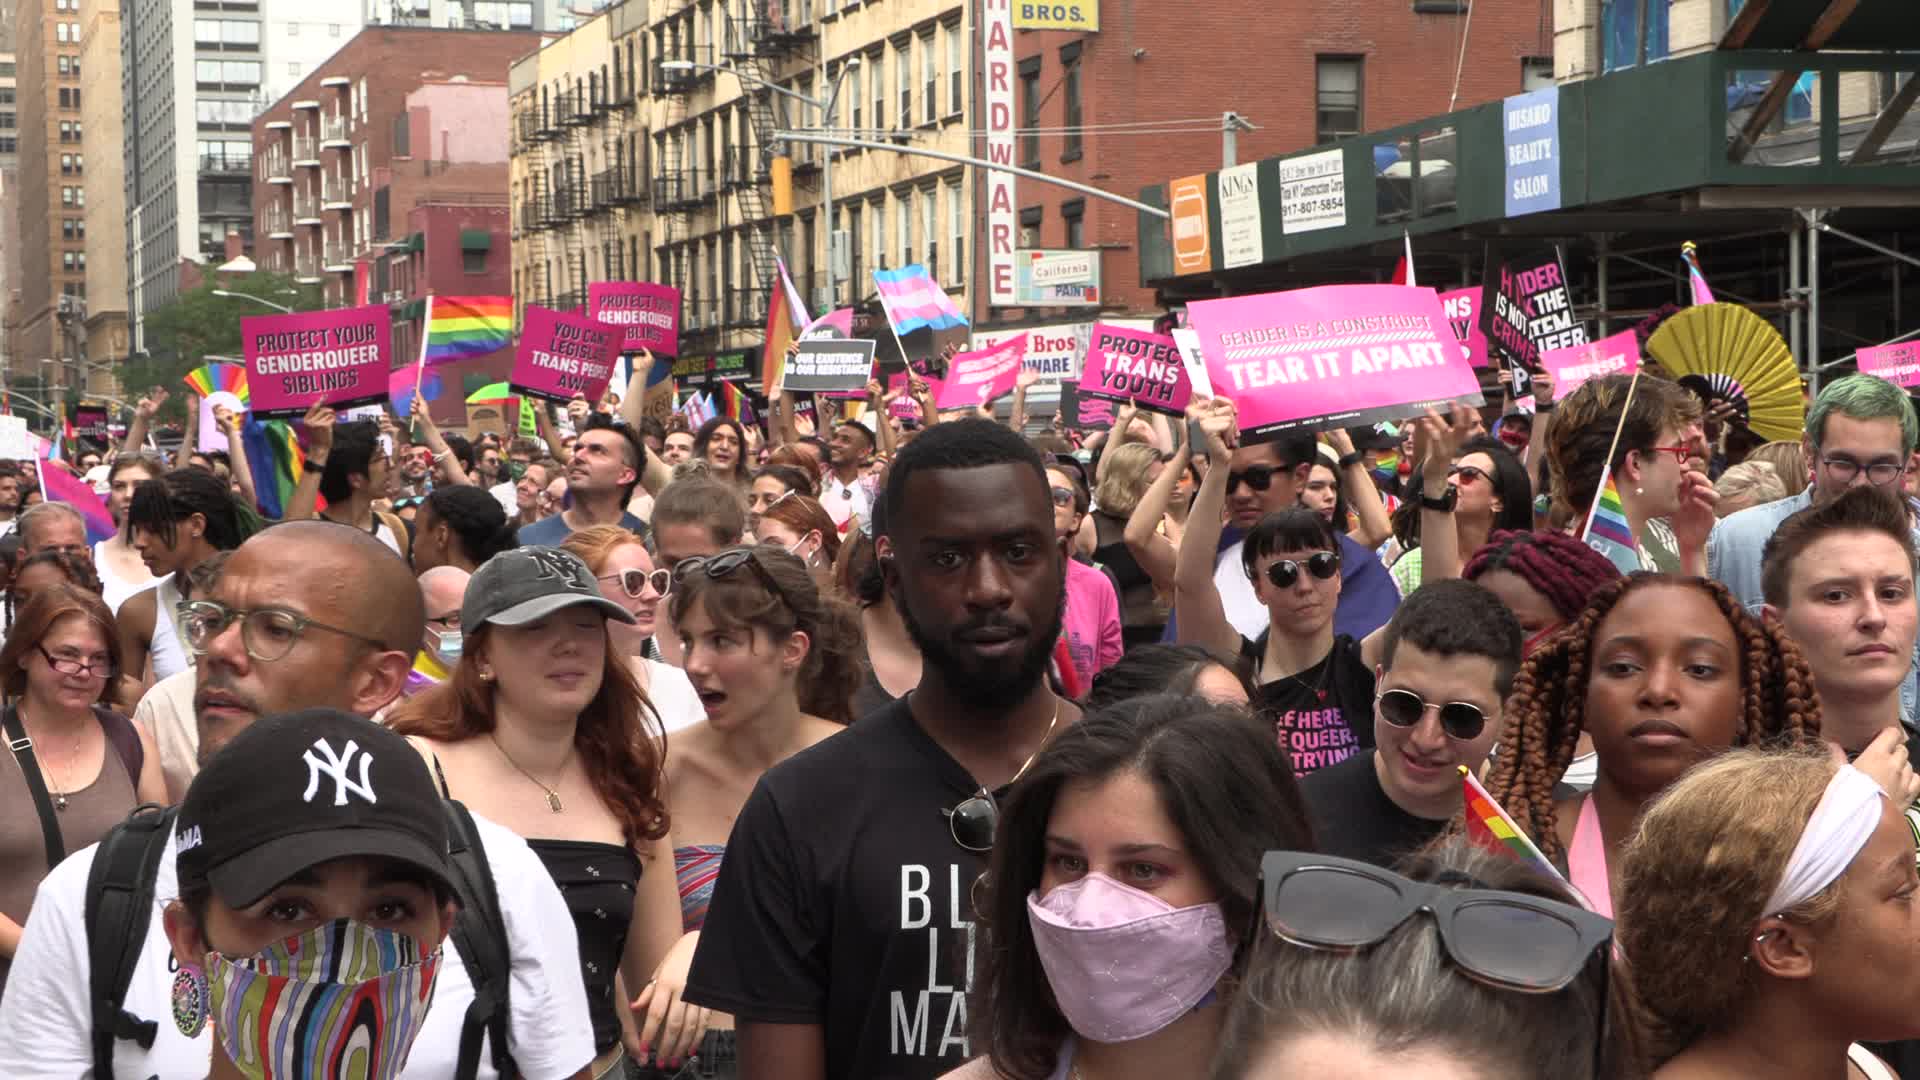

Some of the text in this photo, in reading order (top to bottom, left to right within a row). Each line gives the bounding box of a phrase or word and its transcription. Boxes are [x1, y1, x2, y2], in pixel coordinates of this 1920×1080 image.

[1021, 4, 1086, 22] BROS.
[1508, 103, 1551, 131] HISAKO
[1508, 138, 1552, 166] BEAUTY
[1222, 175, 1254, 198] KINGS
[1513, 175, 1549, 200] SALON
[1281, 197, 1343, 216] 917-807-5854
[1036, 264, 1088, 277] California
[599, 295, 654, 310] PROTECT
[1495, 292, 1507, 317] IS
[1507, 302, 1528, 336] NOT
[1534, 287, 1568, 315] THE
[554, 322, 582, 341] YOU
[598, 310, 673, 330] GENDERQUEER
[1219, 327, 1288, 347] GENDER
[1293, 324, 1310, 338] IS
[1316, 322, 1328, 336] A
[1331, 314, 1432, 335] CONSTRUCT
[256, 324, 376, 353] PROTECT YOUR
[1033, 335, 1076, 353] Bros
[1098, 333, 1184, 367] PROTEC
[1492, 315, 1536, 367] CRIME
[256, 345, 379, 375] GENDERQUEER
[531, 350, 579, 375] TRANS
[795, 353, 864, 364] OUR EXISTENCE
[796, 364, 815, 375] OUR
[817, 364, 869, 375] RESISTANCE
[1104, 352, 1180, 384] TRANS
[1225, 354, 1308, 391] TEAR
[1311, 352, 1341, 379] IT
[1351, 341, 1447, 375] APART
[283, 369, 359, 395] SIBLINGS
[1101, 370, 1176, 404] YOUTH
[1290, 728, 1358, 752] QUEER,
[302, 737, 377, 806] NY
